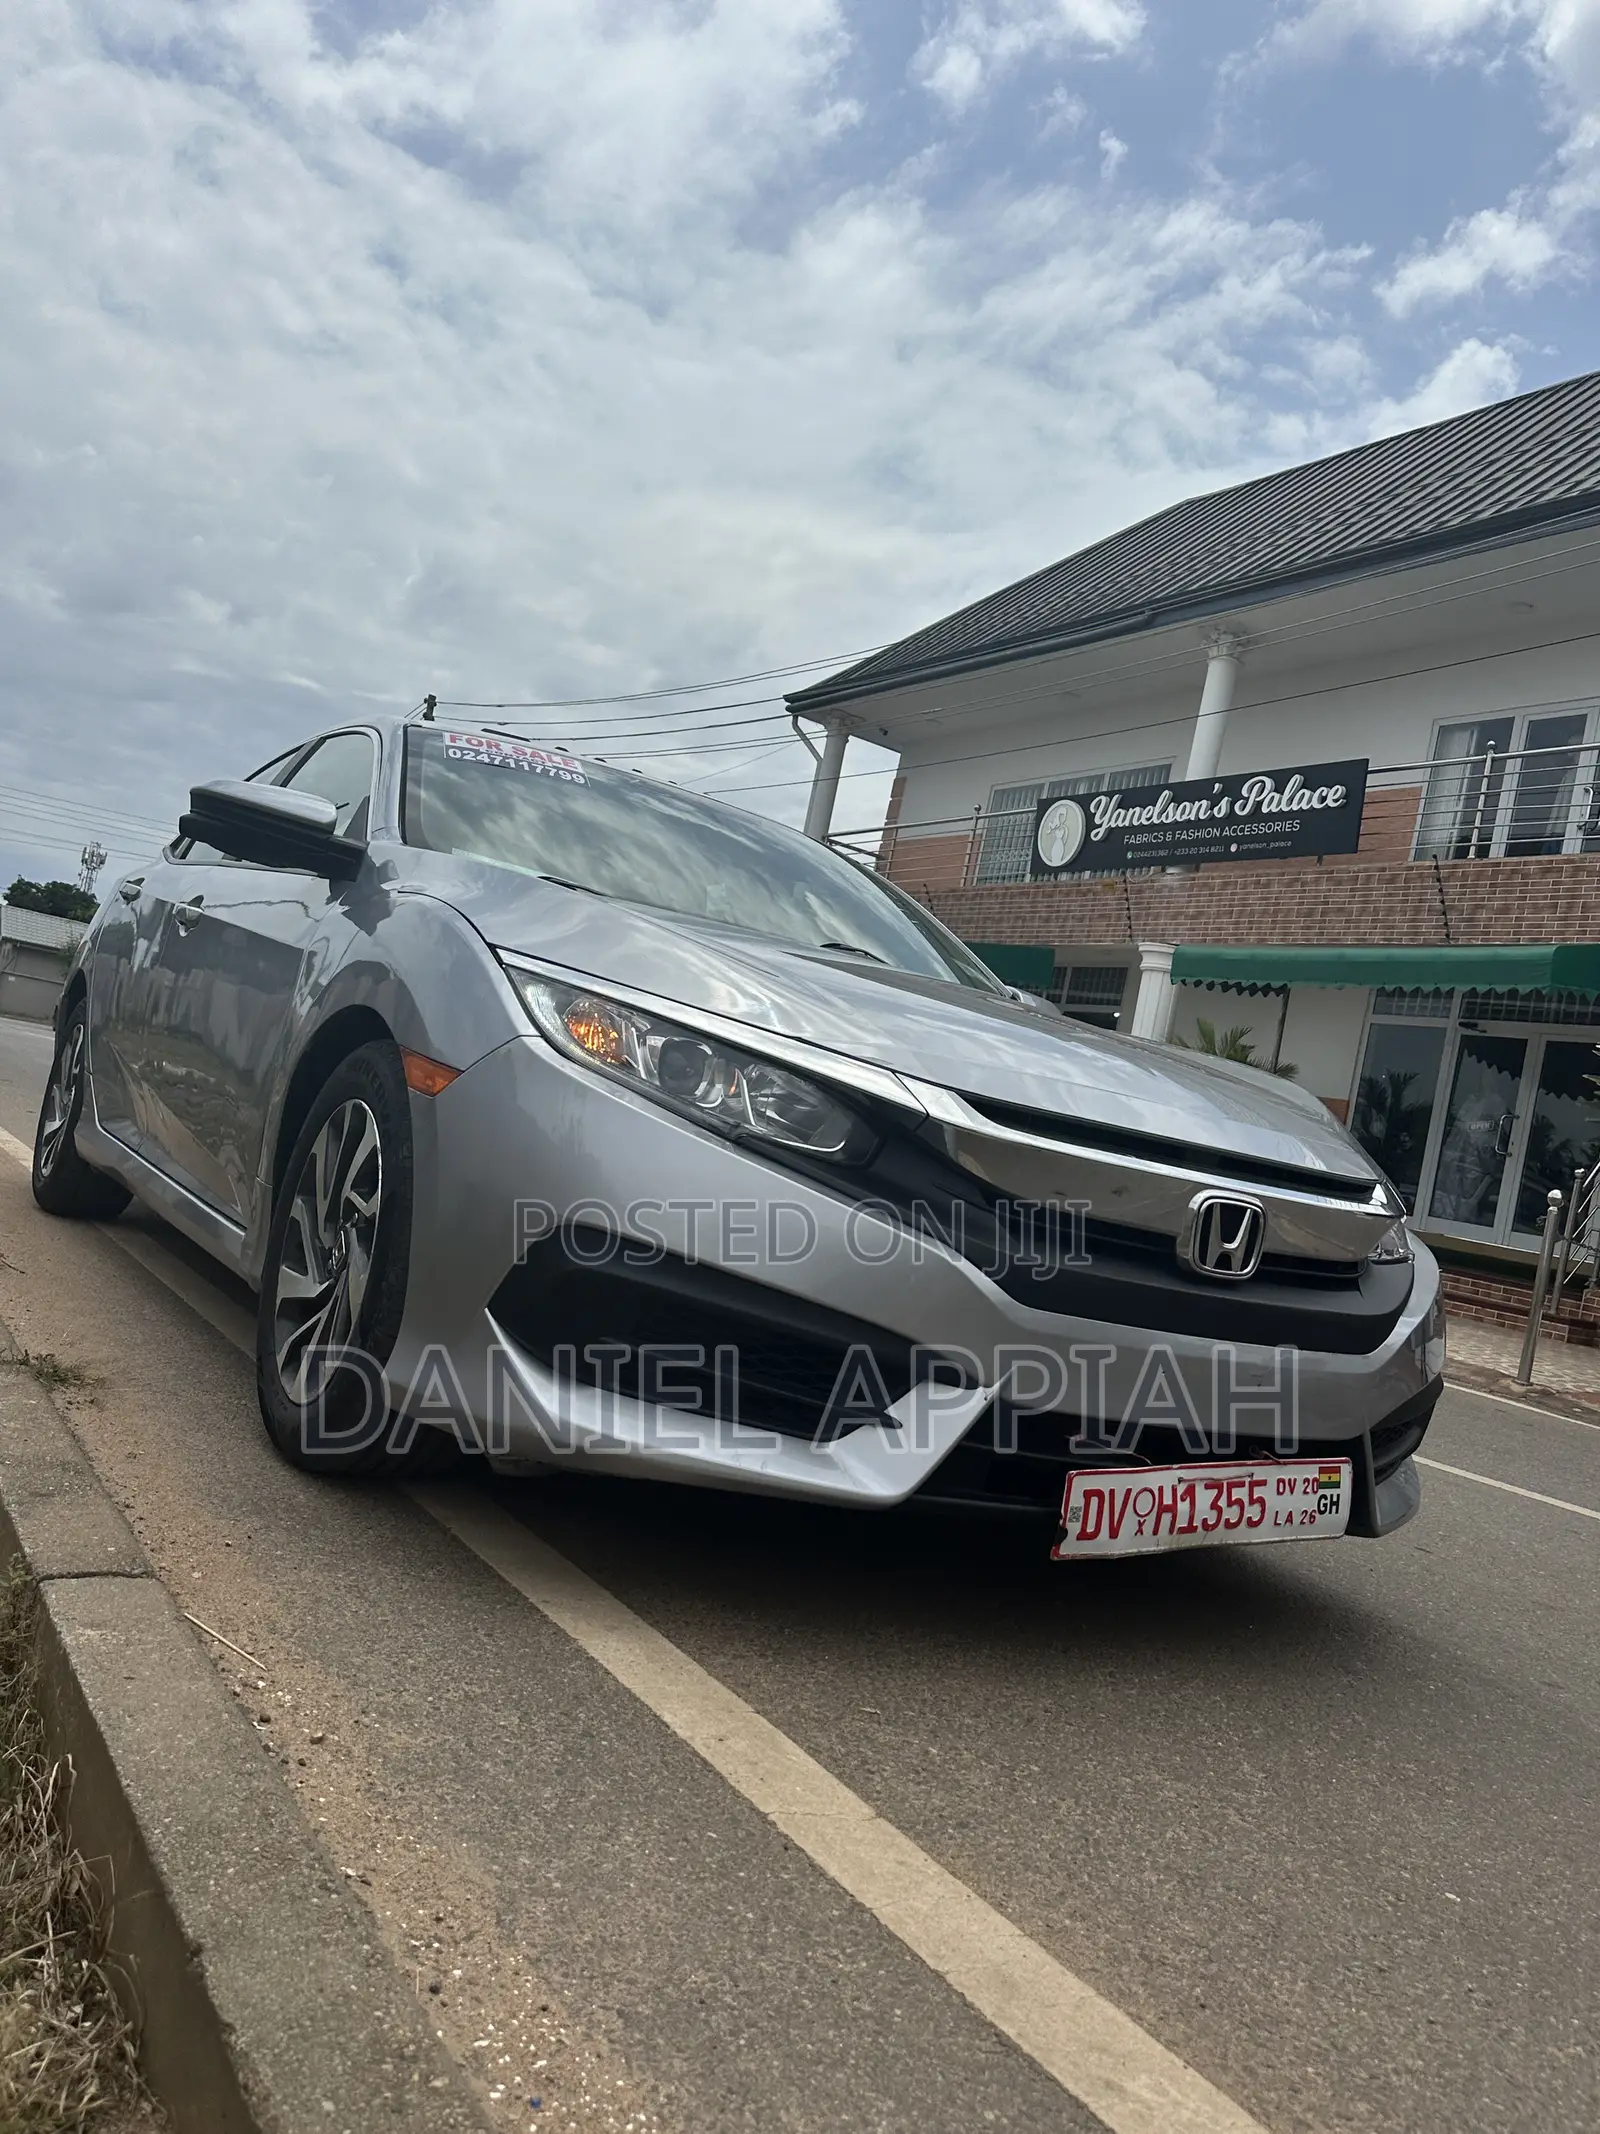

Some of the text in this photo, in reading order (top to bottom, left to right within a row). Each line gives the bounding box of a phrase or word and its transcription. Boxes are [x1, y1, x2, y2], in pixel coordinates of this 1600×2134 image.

[448, 748, 586, 784] 0247117799
[450, 734, 579, 770] FOR SALE
[1090, 773, 1347, 842] Yanelson's Palace
[1123, 819, 1301, 845] FABRICS & FASHION ACCESSORIES
[1276, 1476, 1320, 1496] DV 20
[1076, 1487, 1132, 1541] DV
[1299, 1509, 1317, 1525] 26
[1317, 1493, 1341, 1515] GH
